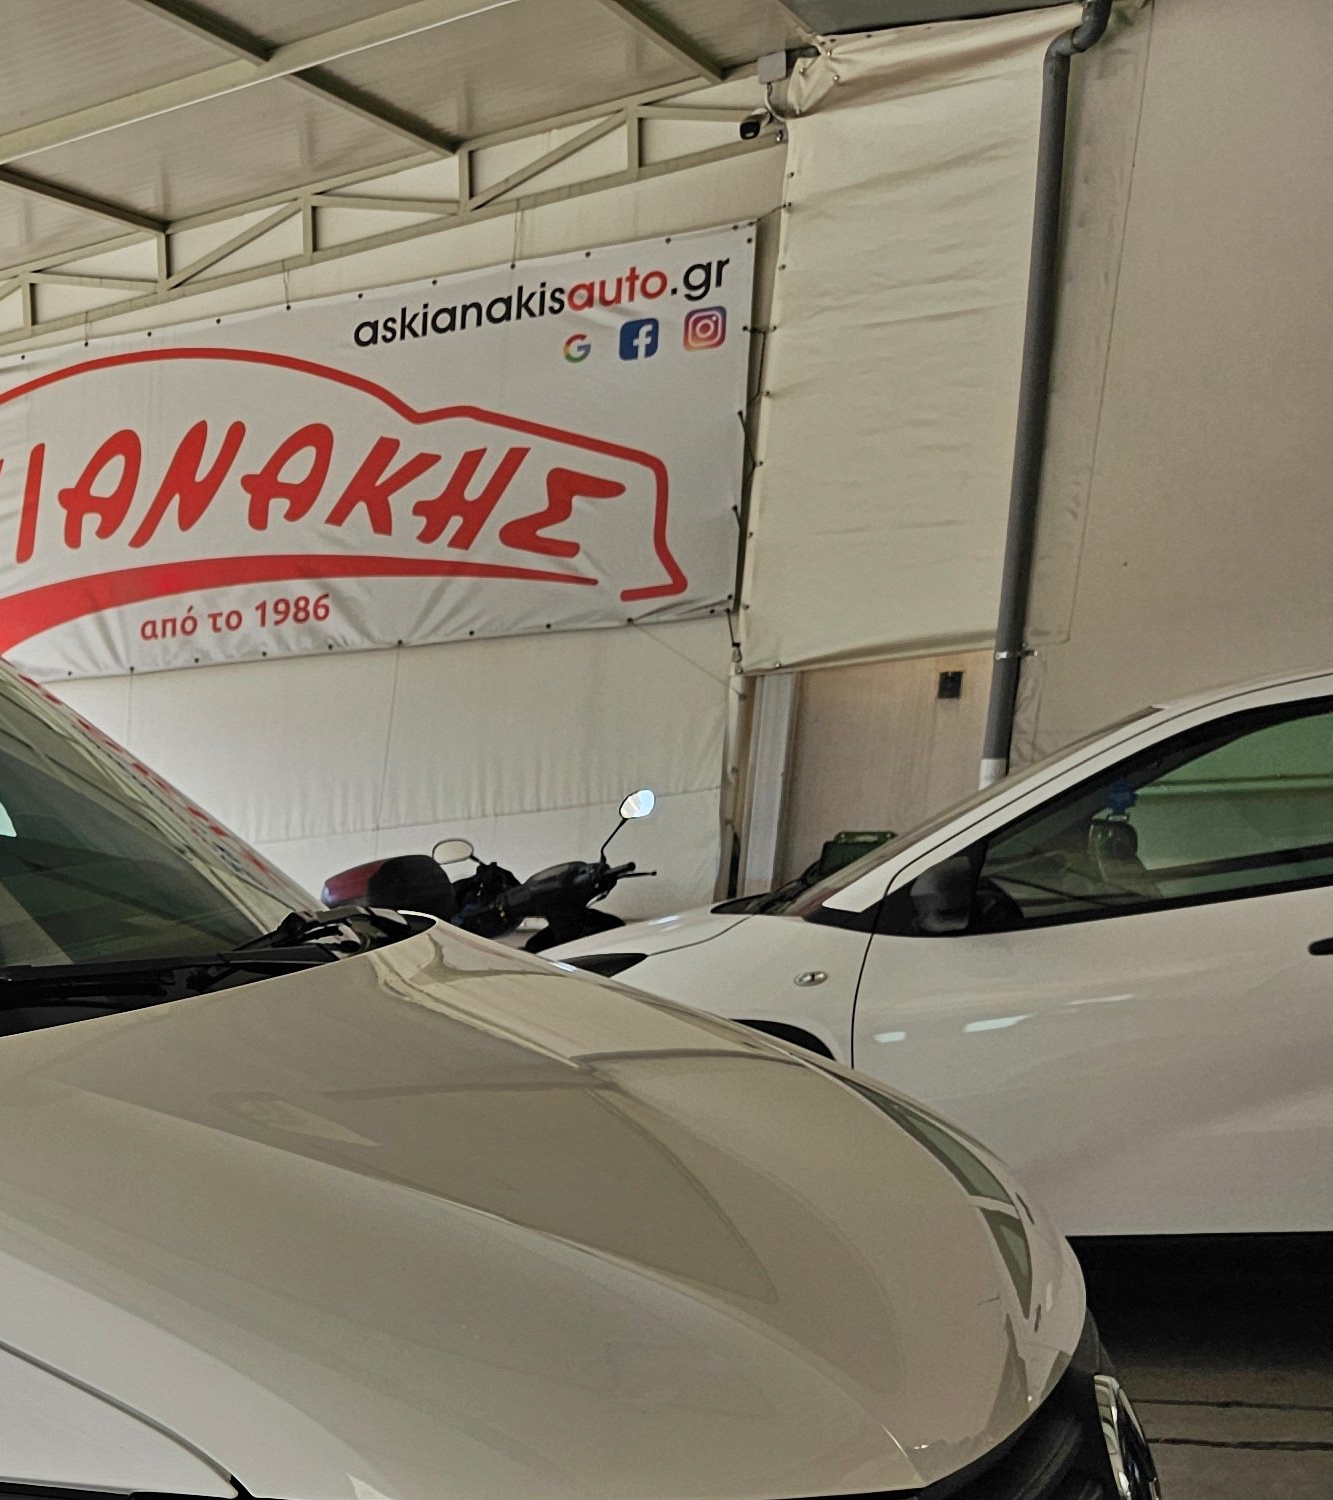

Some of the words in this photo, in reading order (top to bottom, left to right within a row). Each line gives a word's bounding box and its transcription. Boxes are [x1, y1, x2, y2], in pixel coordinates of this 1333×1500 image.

[353, 257, 730, 348] askianakisauto.gr
[140, 604, 199, 642] από
[207, 608, 244, 634] το
[254, 591, 331, 629] 1986
